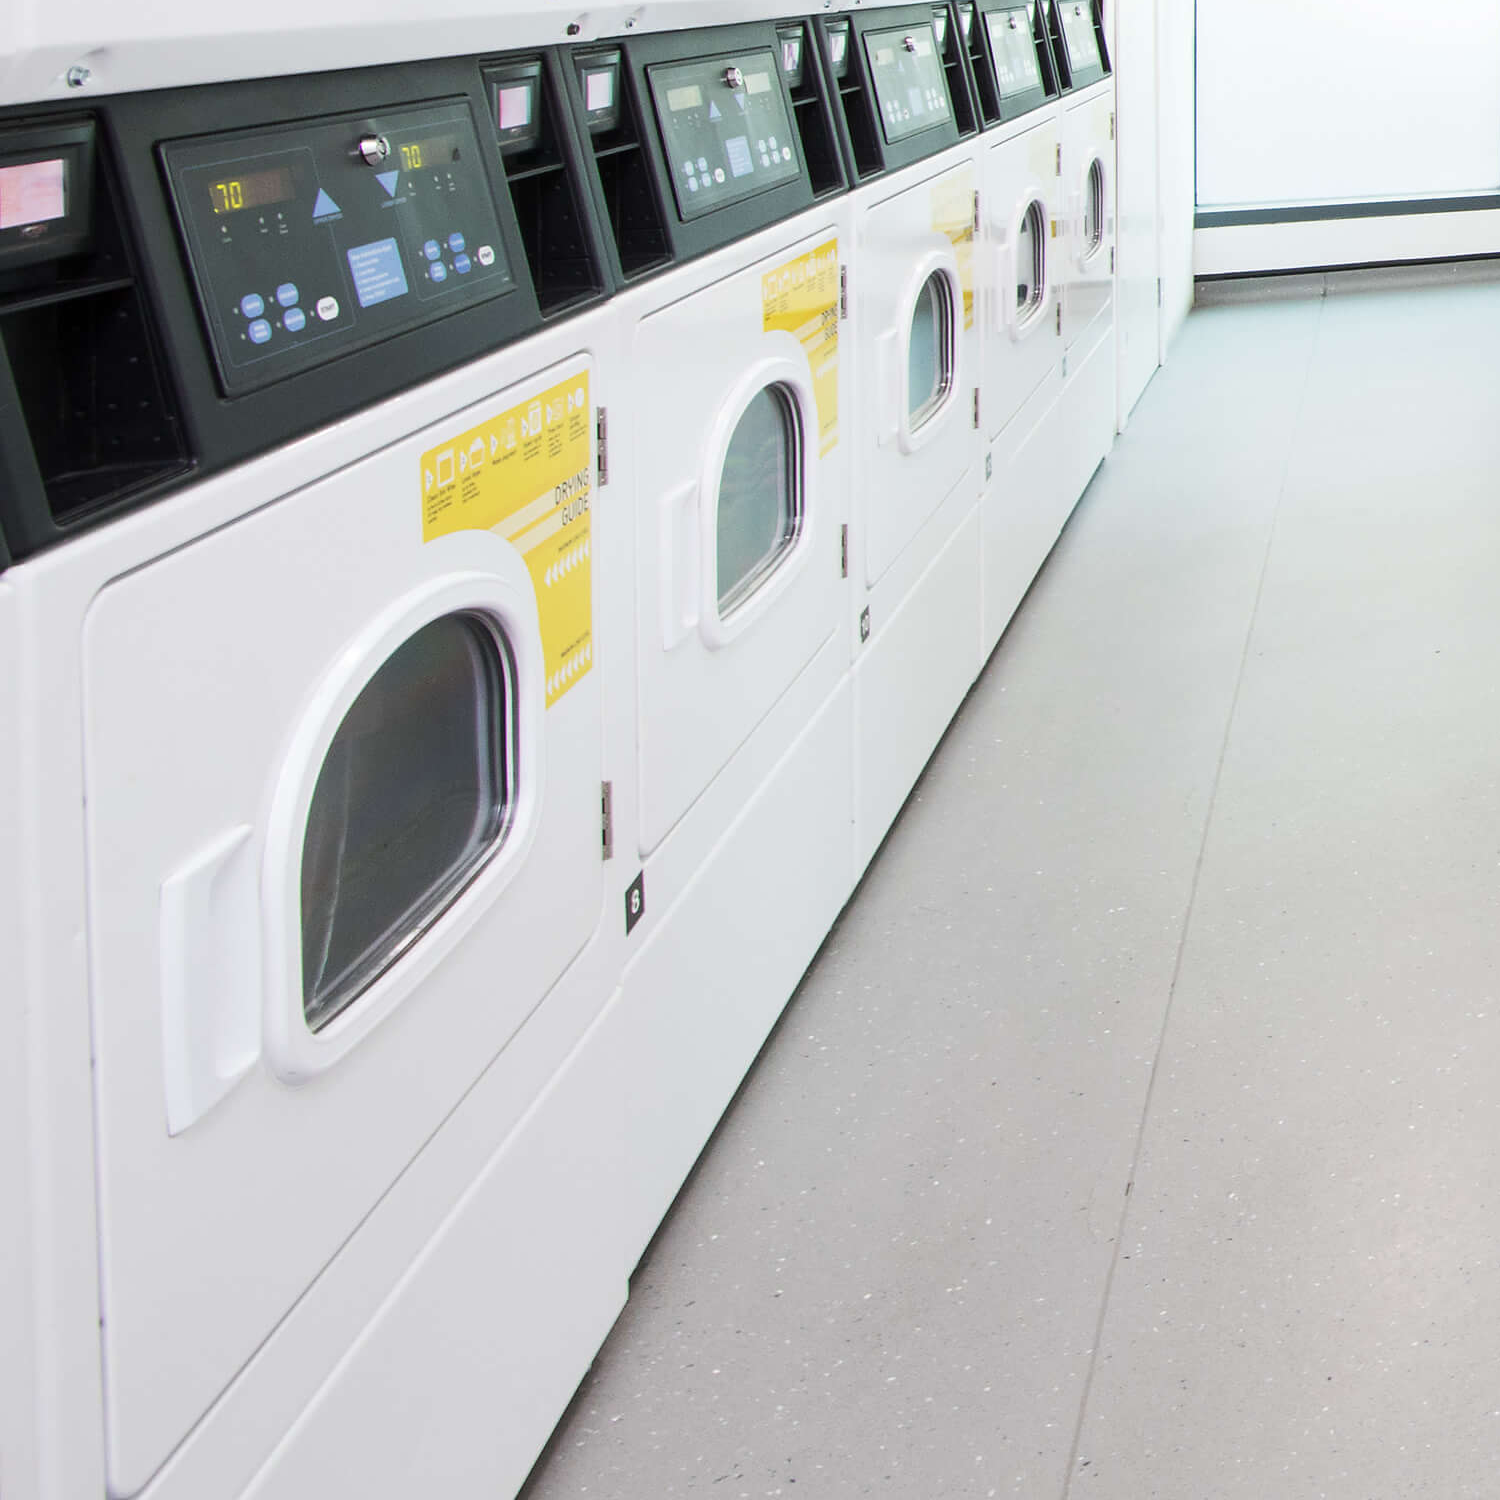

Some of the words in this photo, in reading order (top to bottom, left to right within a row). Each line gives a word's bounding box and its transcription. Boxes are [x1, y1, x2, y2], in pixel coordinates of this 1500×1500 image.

[555, 467, 589, 505] DRYING
[563, 492, 589, 526] GUIDE
[631, 889, 640, 914] 8
